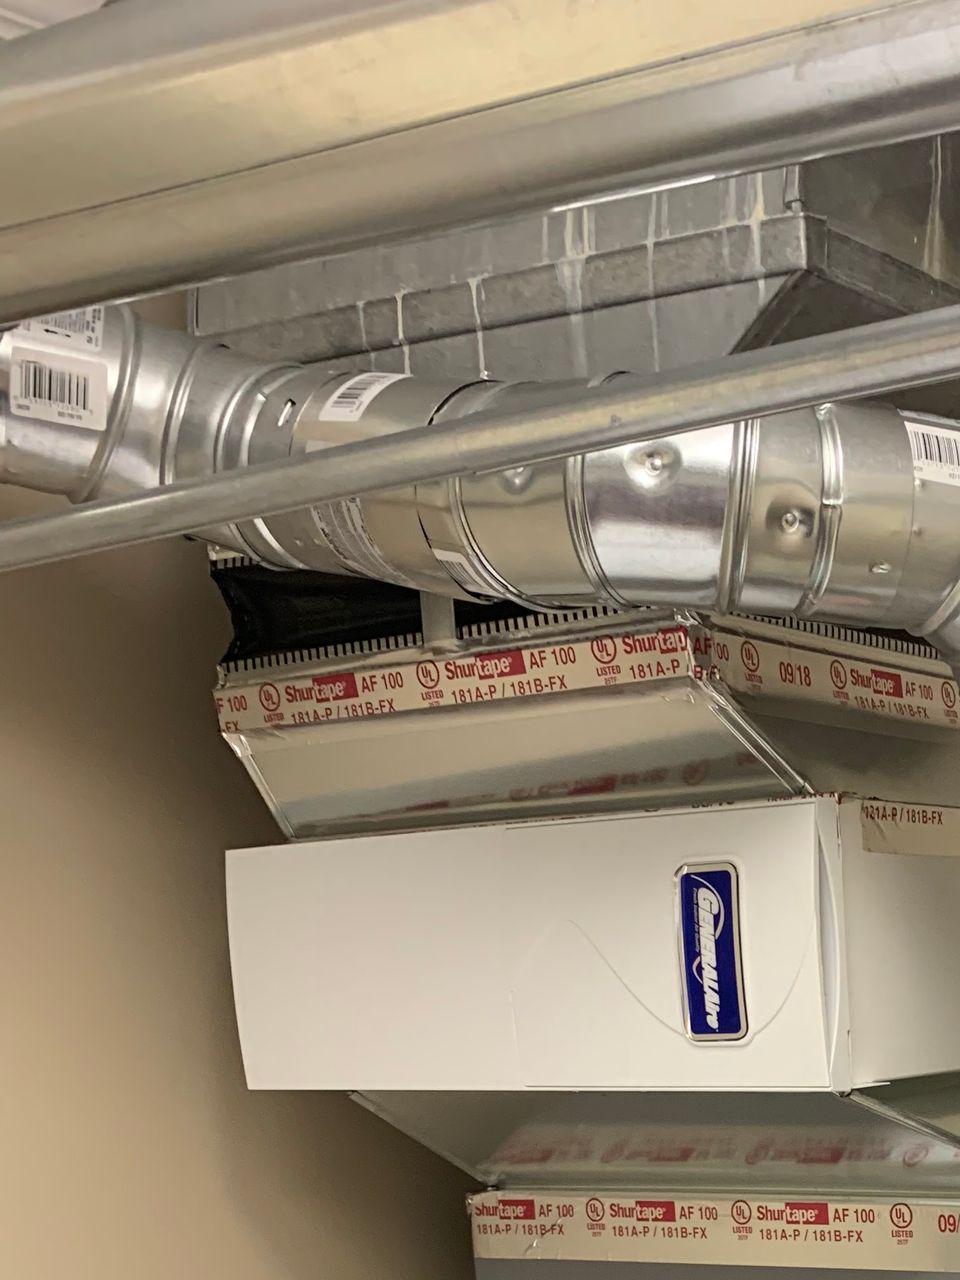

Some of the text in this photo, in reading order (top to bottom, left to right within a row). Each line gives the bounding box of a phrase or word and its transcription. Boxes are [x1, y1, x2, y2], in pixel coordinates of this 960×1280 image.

[693, 637, 712, 655] AF
[444, 646, 576, 680] Shurtape AF 100
[596, 664, 621, 677] LISTED
[629, 659, 681, 680] 181A-P
[779, 661, 812, 687] 09/18
[285, 672, 403, 703] Shurtape AF 100
[451, 675, 568, 704] 181A-P 181B-FX
[850, 668, 933, 701] Shurtape AF 100
[227, 695, 248, 712] 100
[421, 690, 444, 701] LISTED
[291, 698, 396, 725] 181A-P 181B-FX
[854, 696, 930, 719] 181A-P 181B-FX
[906, 809, 943, 825] 181B-FX
[475, 1202, 574, 1218] Shurtape AF 100
[609, 1203, 718, 1220] Shurtape AF 100
[756, 1205, 875, 1223] Shurtape AF 100
[477, 1224, 564, 1236] 181A-P 181B-FX
[587, 1223, 605, 1231] LISTED
[612, 1226, 650, 1237] 181A-P
[661, 1227, 708, 1239] 181B-FX
[732, 1226, 752, 1234] LISTED
[891, 1230, 913, 1238] LISTED
[759, 1229, 801, 1241] 181A-P
[813, 1229, 863, 1243] 181B-FX
